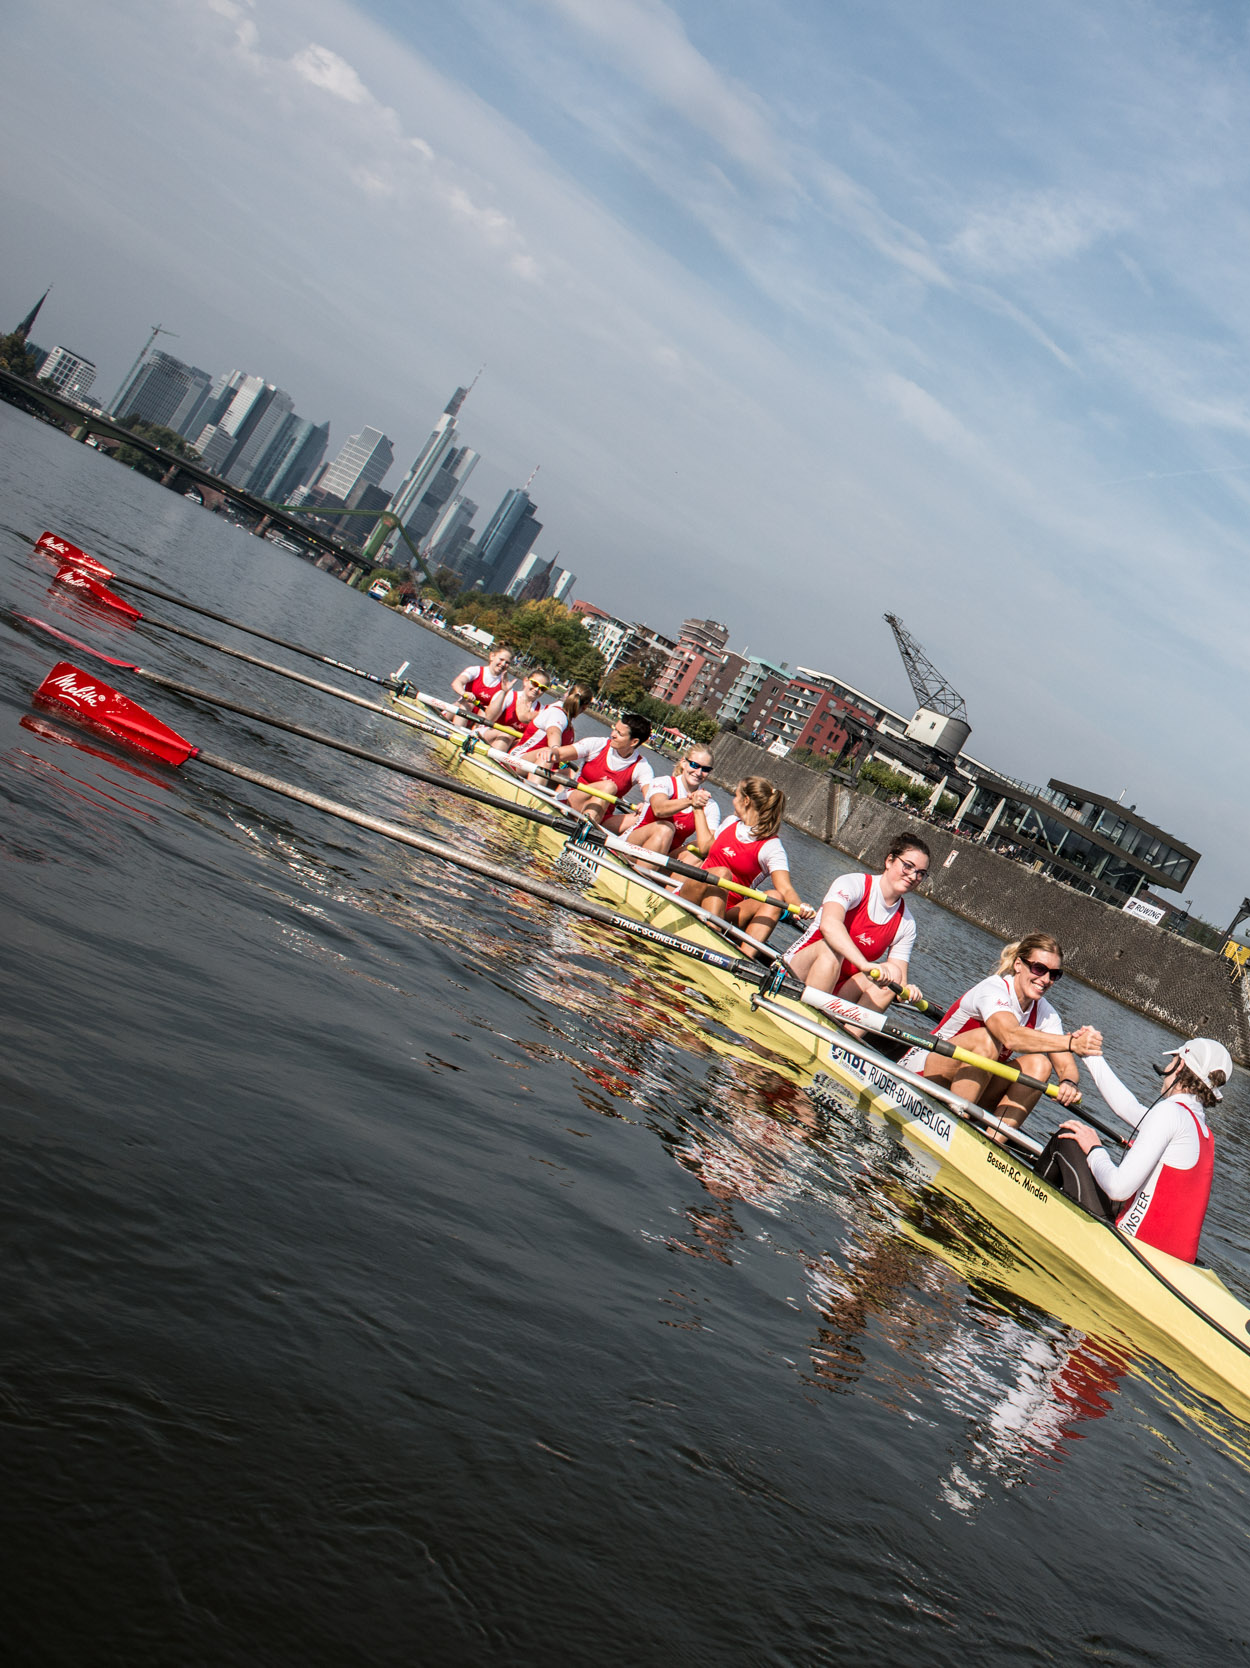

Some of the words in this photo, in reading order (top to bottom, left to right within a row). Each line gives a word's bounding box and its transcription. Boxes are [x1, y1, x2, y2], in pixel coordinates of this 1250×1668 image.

[1135, 904, 1161, 920] ROWING
[613, 915, 642, 933] STARK.
[641, 928, 680, 948] SCHNELL.
[680, 942, 700, 957] GUT.
[868, 1066, 951, 1142] RUDER-BUNDESLIGA
[986, 1151, 1021, 1185] Bessel-R.C.
[1021, 1177, 1048, 1204] Minden
